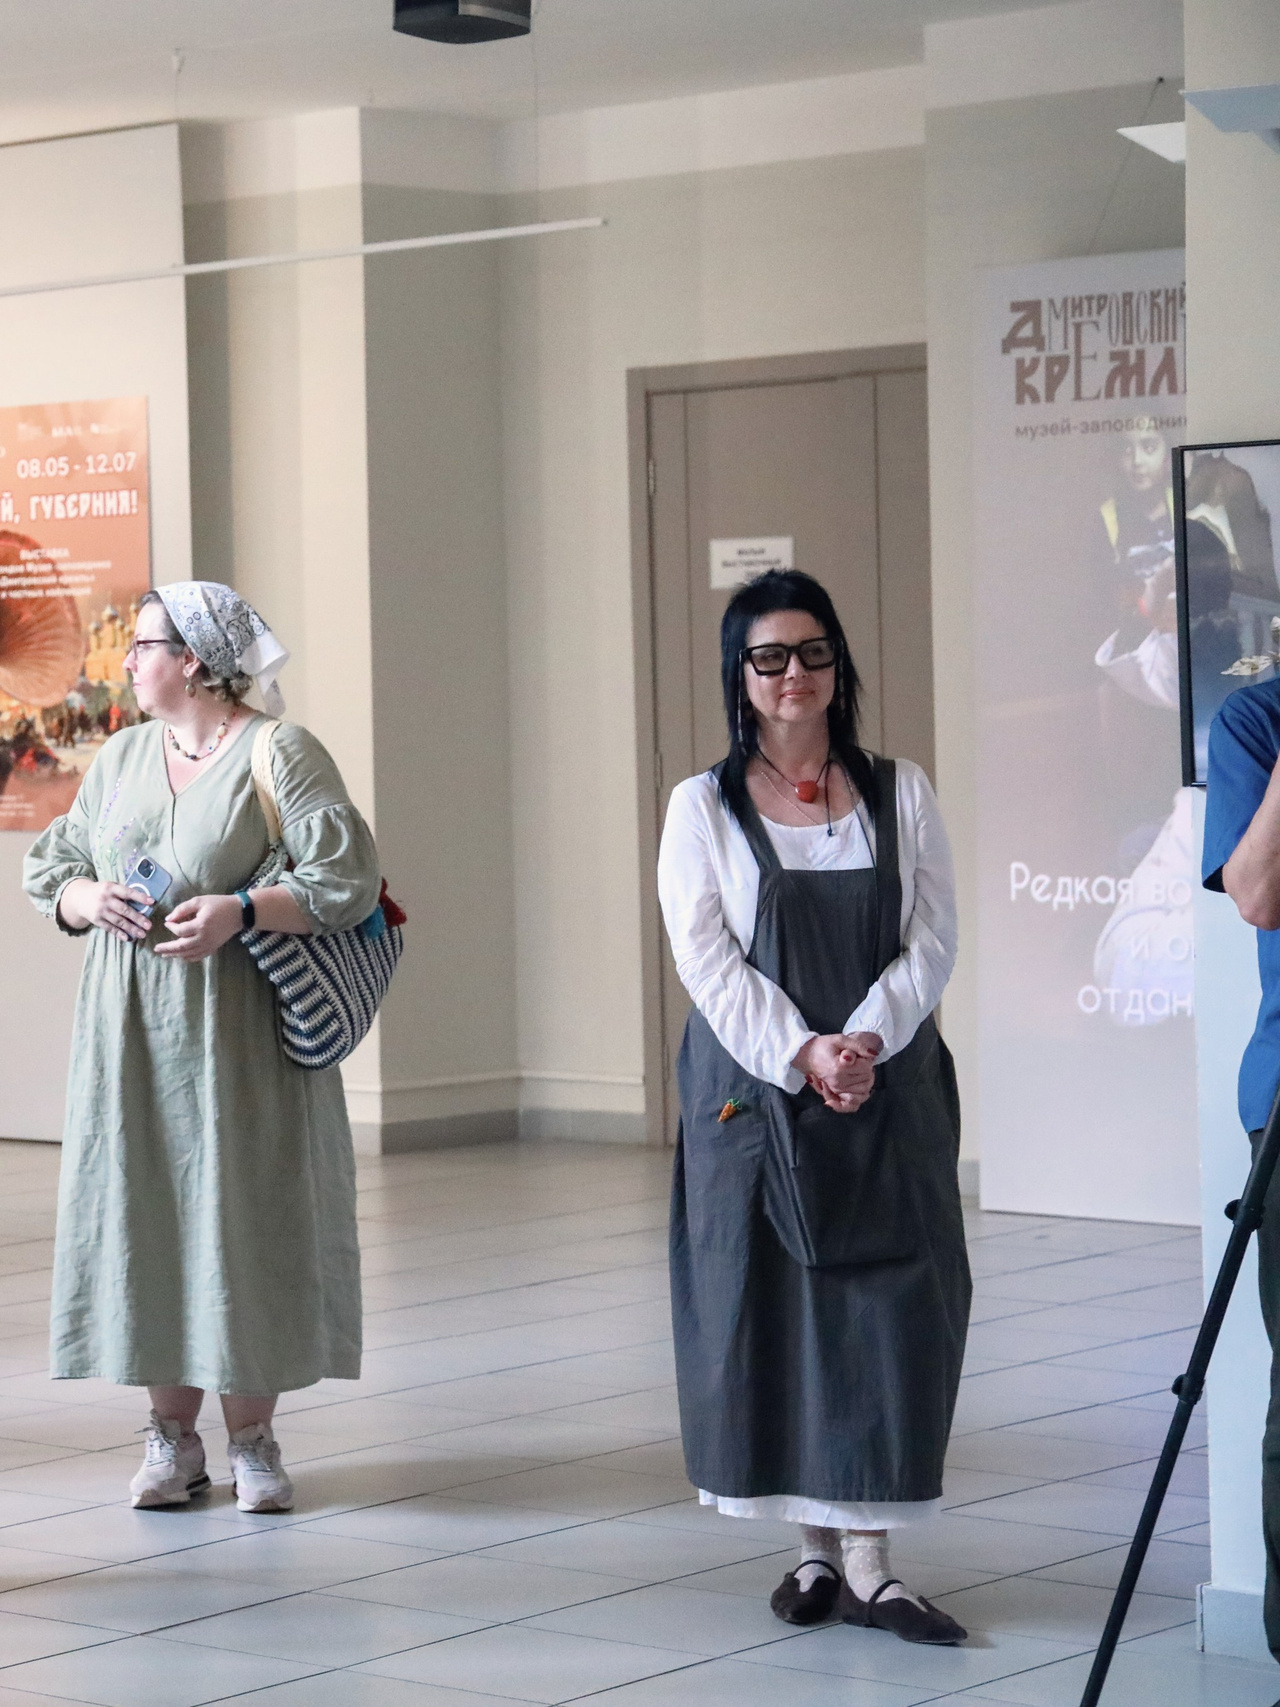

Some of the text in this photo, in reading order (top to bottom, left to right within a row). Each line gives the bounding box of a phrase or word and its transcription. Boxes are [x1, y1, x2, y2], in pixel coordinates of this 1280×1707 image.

[1015, 318, 1186, 406] КРЕМЛ
[17, 456, 70, 479] 08.05
[85, 451, 137, 474] 12.07
[1010, 861, 1134, 911] Редкая
